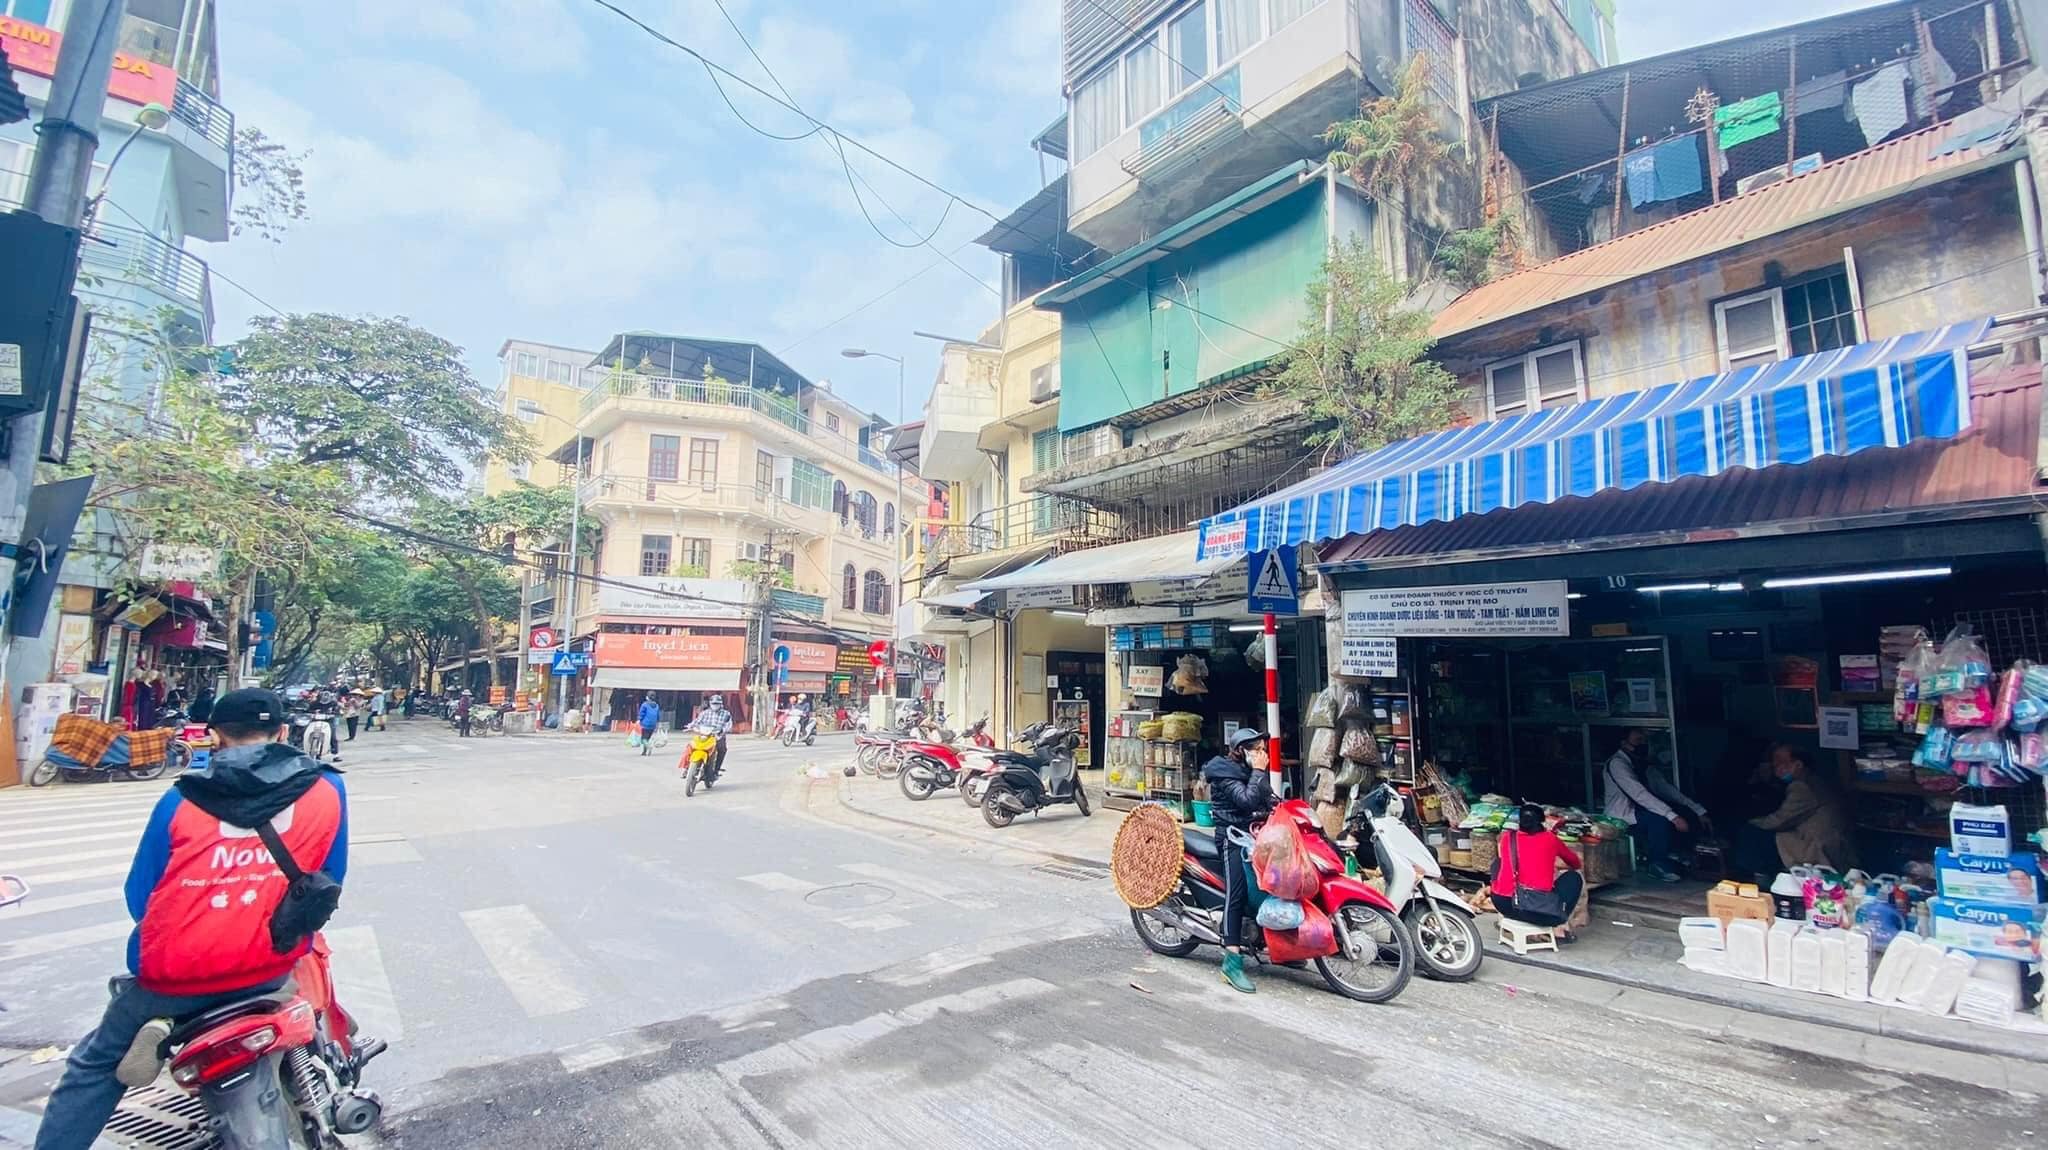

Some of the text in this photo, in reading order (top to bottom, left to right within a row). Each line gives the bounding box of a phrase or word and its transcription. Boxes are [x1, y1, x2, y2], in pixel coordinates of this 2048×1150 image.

[1608, 576, 1626, 588] 10
[1531, 607, 1547, 617] LINH
[1548, 607, 1560, 617] CHI
[1954, 903, 1999, 923] Caryn
